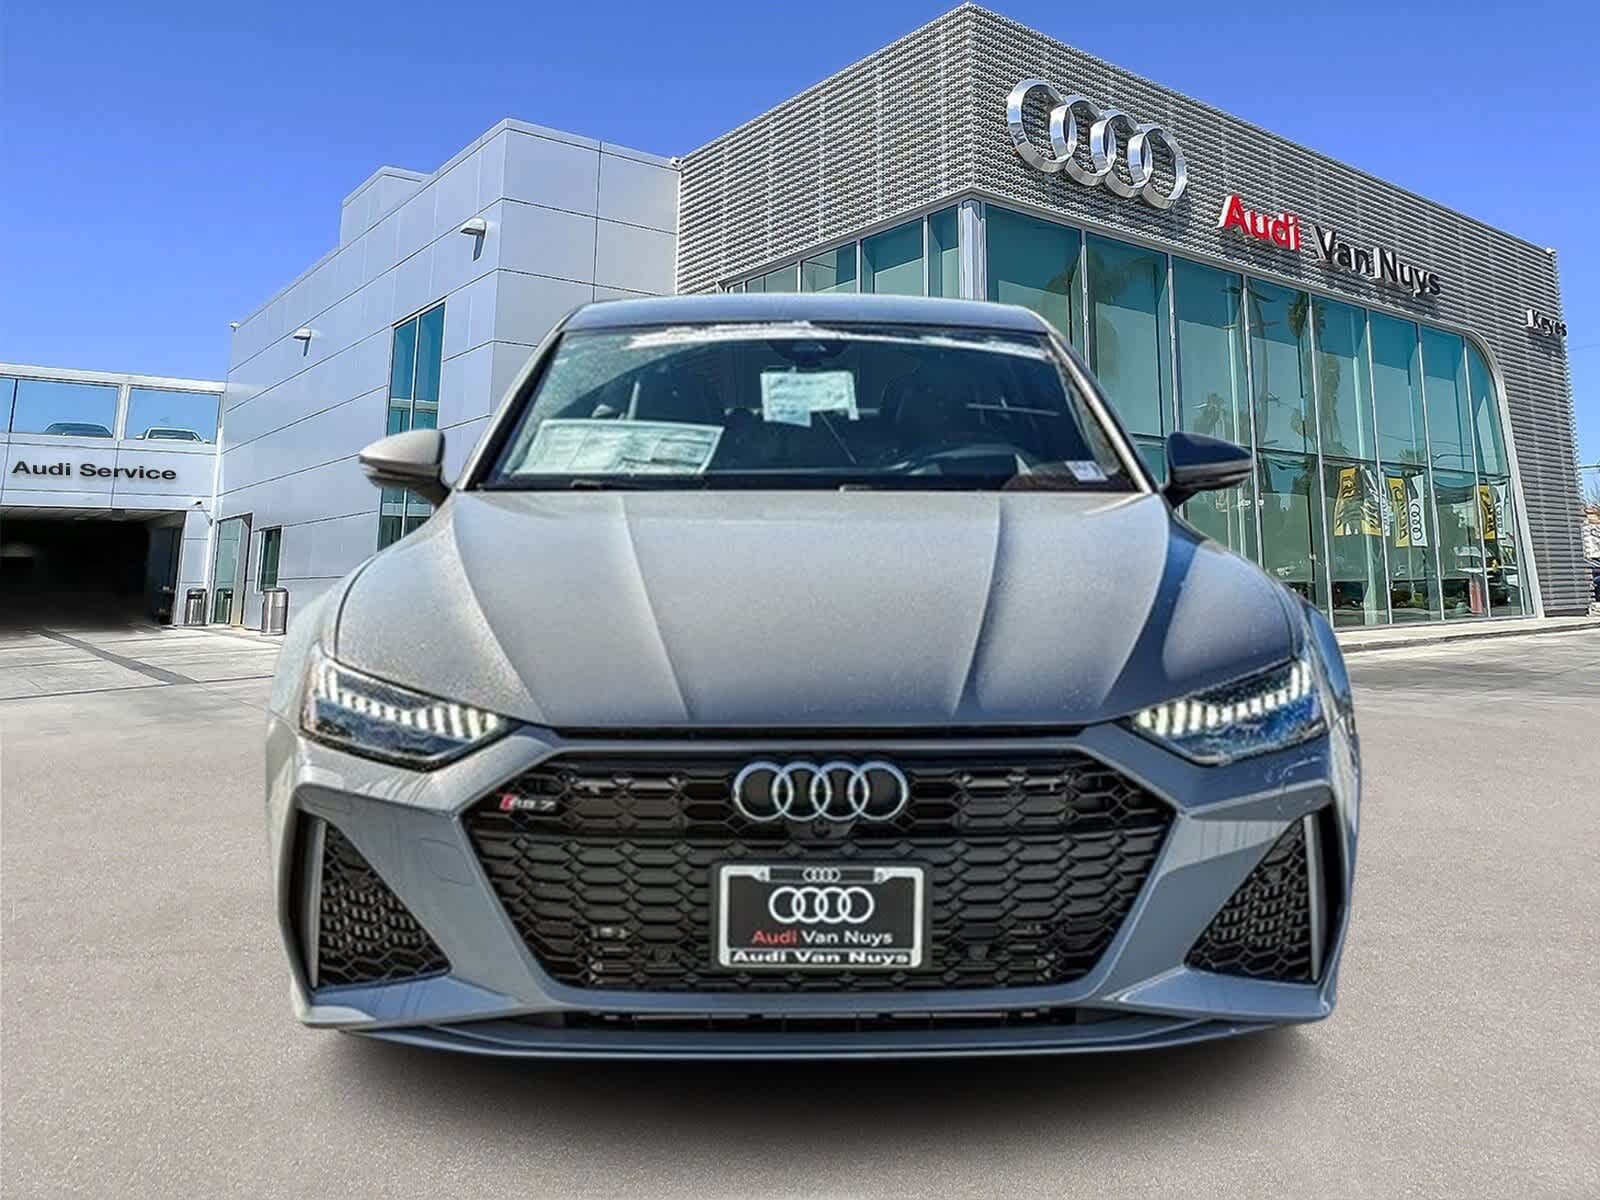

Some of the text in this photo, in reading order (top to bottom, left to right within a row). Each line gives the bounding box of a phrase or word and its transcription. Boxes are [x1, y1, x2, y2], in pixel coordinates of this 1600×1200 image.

[1218, 193, 1441, 297] Audi Van Nuys
[12, 460, 177, 480] Audi Service
[752, 929, 893, 947] Audi Van Nuys
[732, 950, 909, 966] Audi Van Nuys
